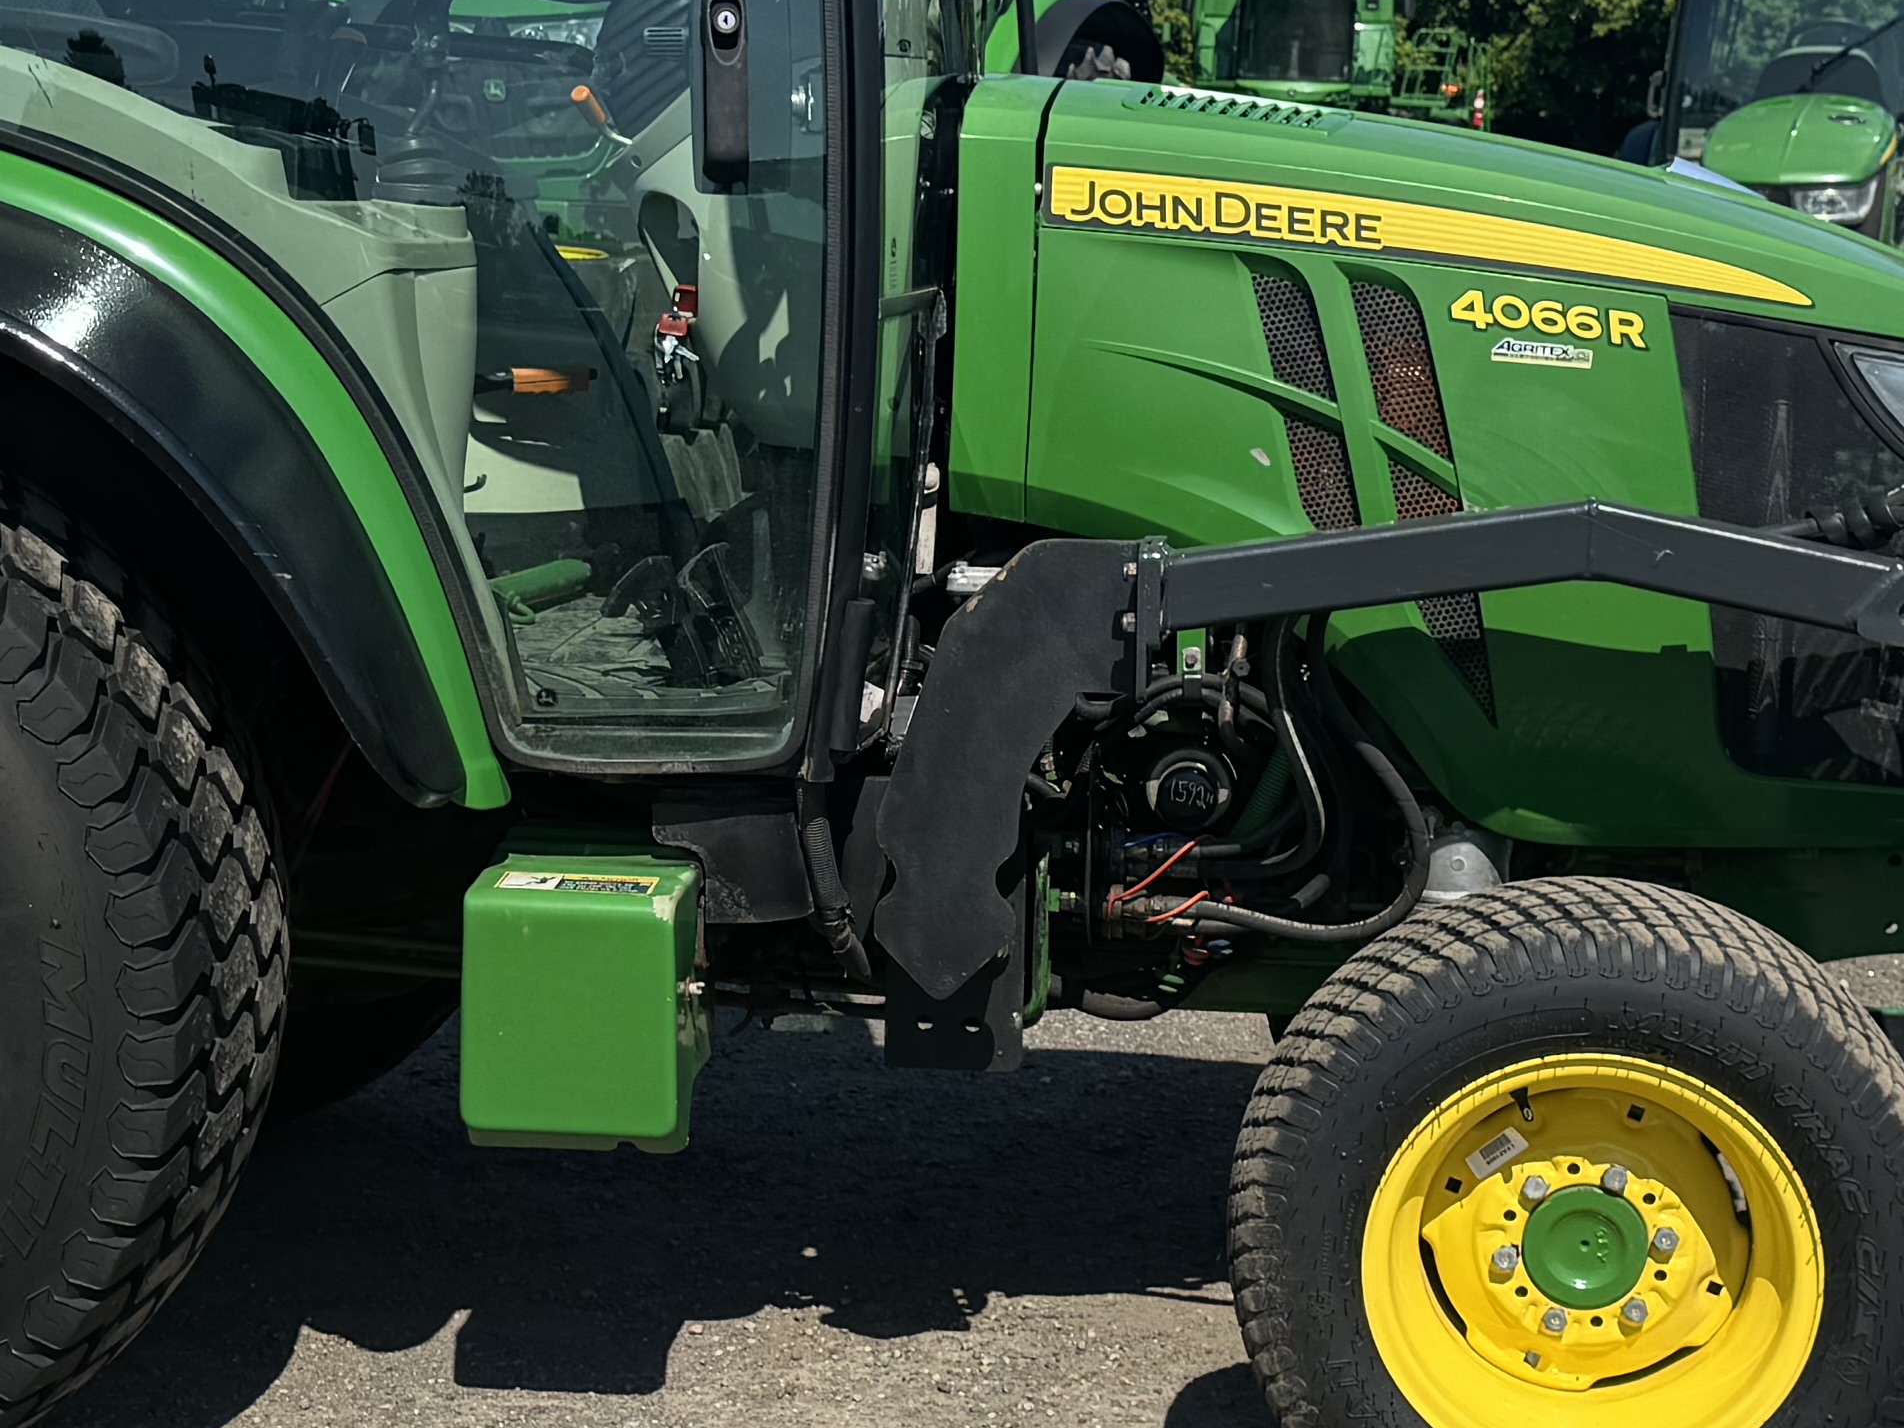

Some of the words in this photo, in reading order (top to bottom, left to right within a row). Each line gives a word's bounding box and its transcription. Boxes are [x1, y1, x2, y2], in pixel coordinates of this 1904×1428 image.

[1069, 179, 1205, 229] JOHN
[1213, 191, 1384, 244] DEERE
[1496, 340, 1570, 357] AGRITEX
[1773, 1083, 1872, 1217] TRAC
